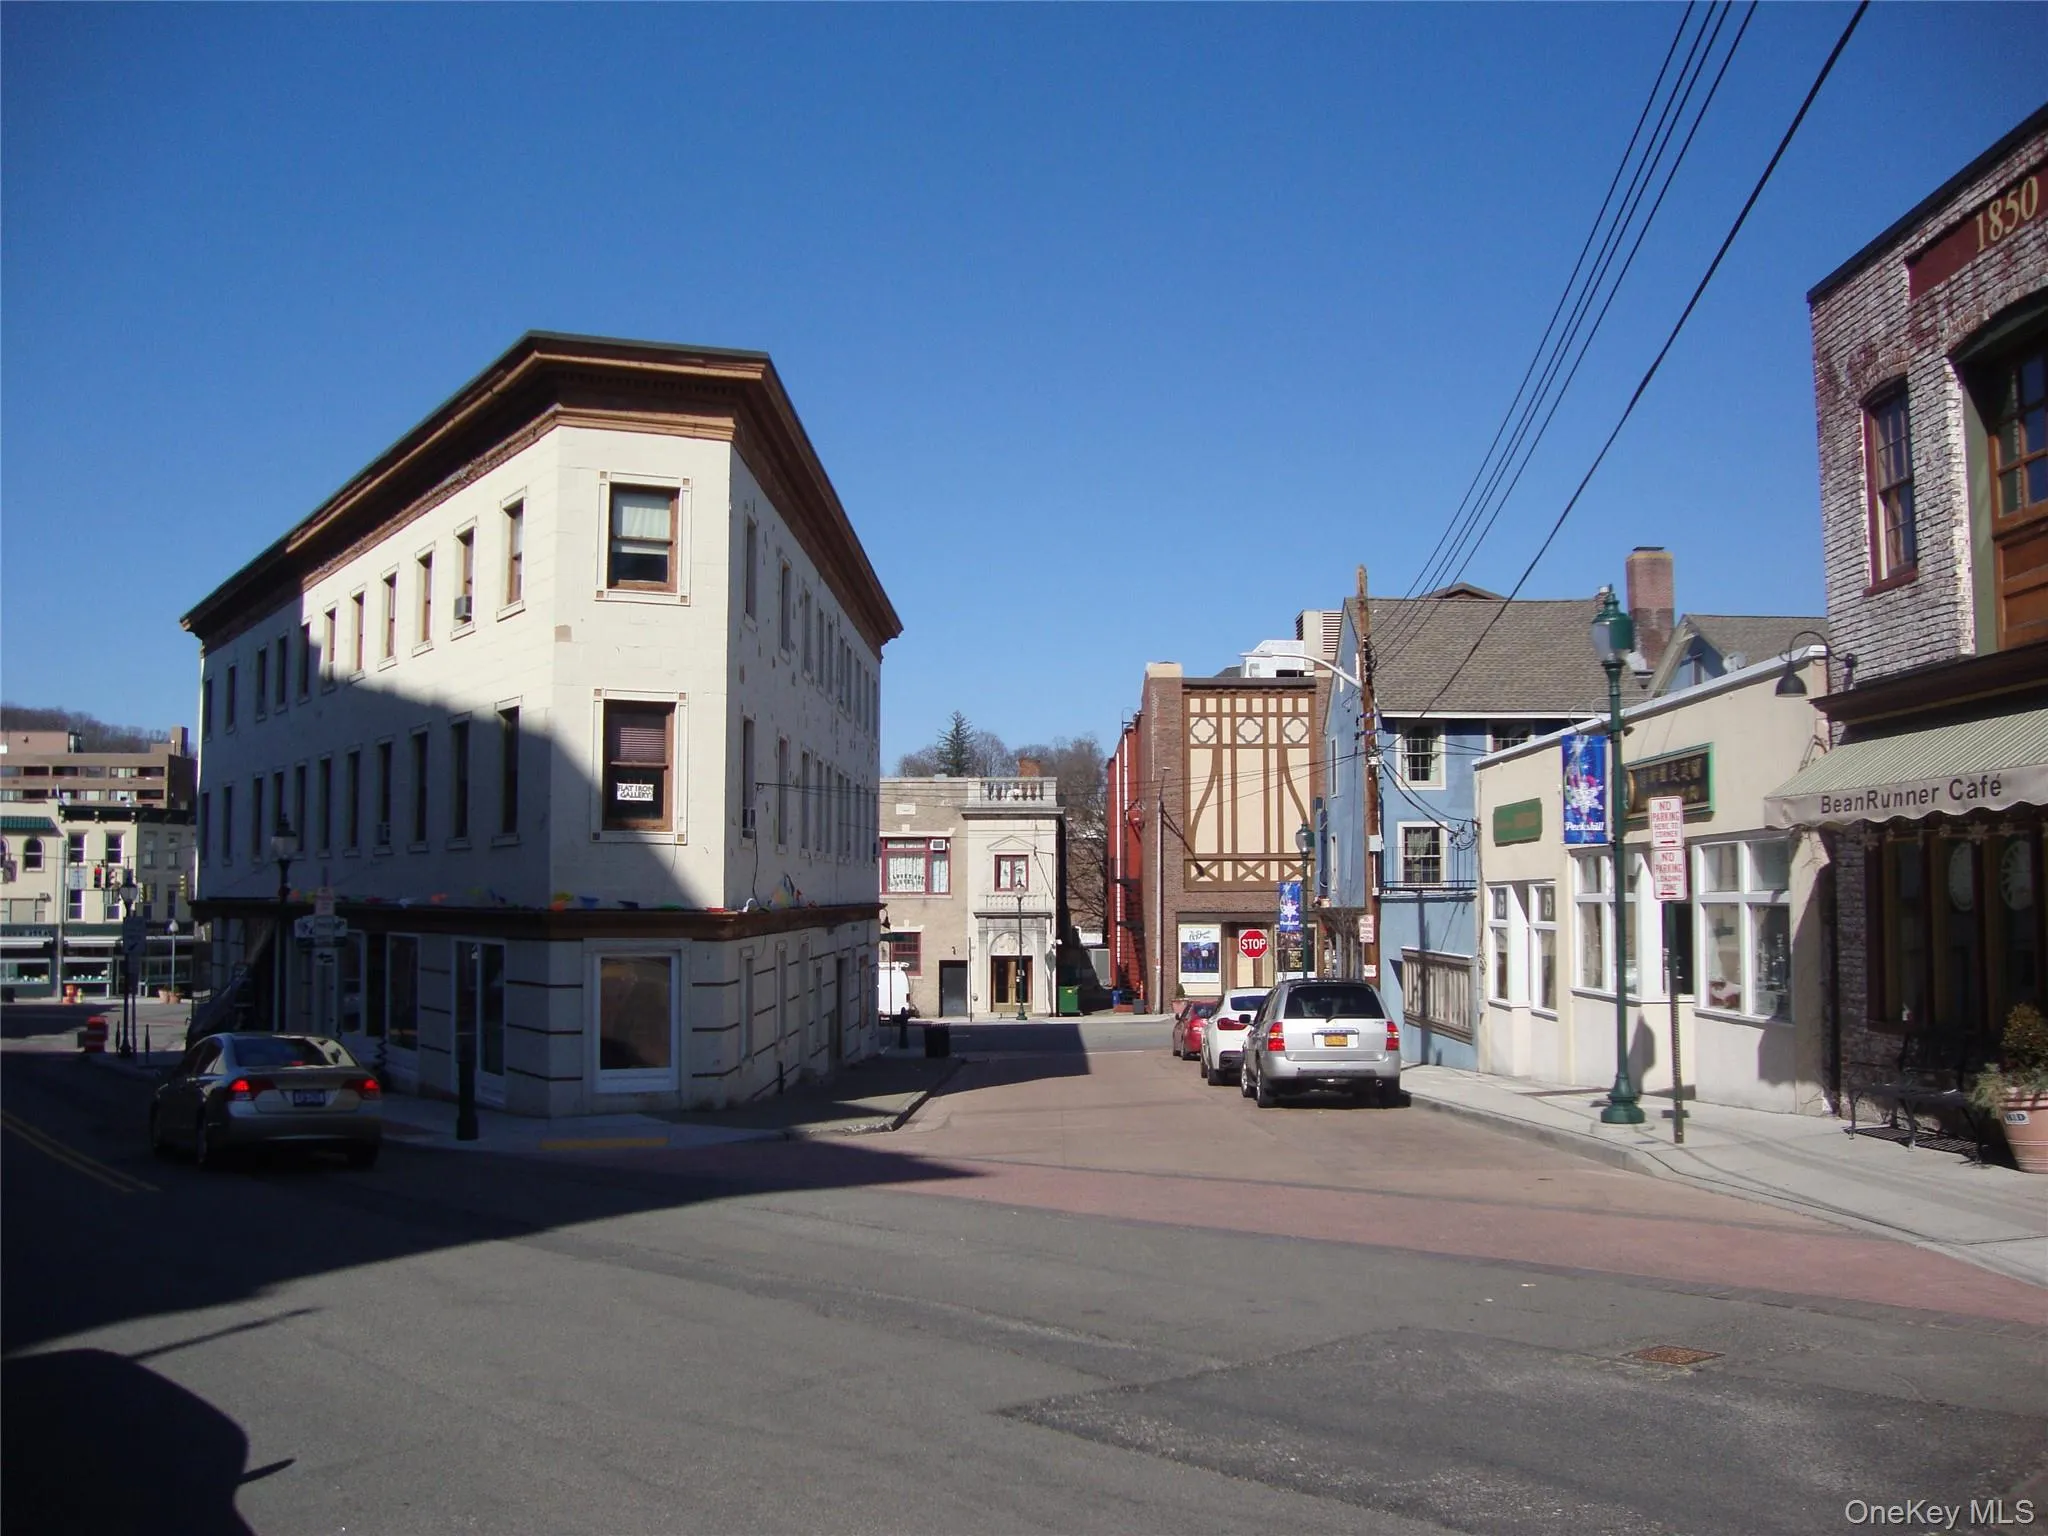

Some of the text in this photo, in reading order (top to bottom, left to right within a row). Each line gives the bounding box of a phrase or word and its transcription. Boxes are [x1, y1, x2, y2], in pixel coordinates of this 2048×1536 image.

[1976, 176, 2038, 252] 1850
[1821, 773, 2002, 813] BeanRunner Café
[1660, 801, 1672, 810] NO
[1652, 812, 1680, 821] PARKING
[1564, 821, 1605, 831] Peekskill
[1661, 853, 1674, 861] NO
[1655, 864, 1682, 873] PARKING
[1241, 938, 1266, 950] STOP
